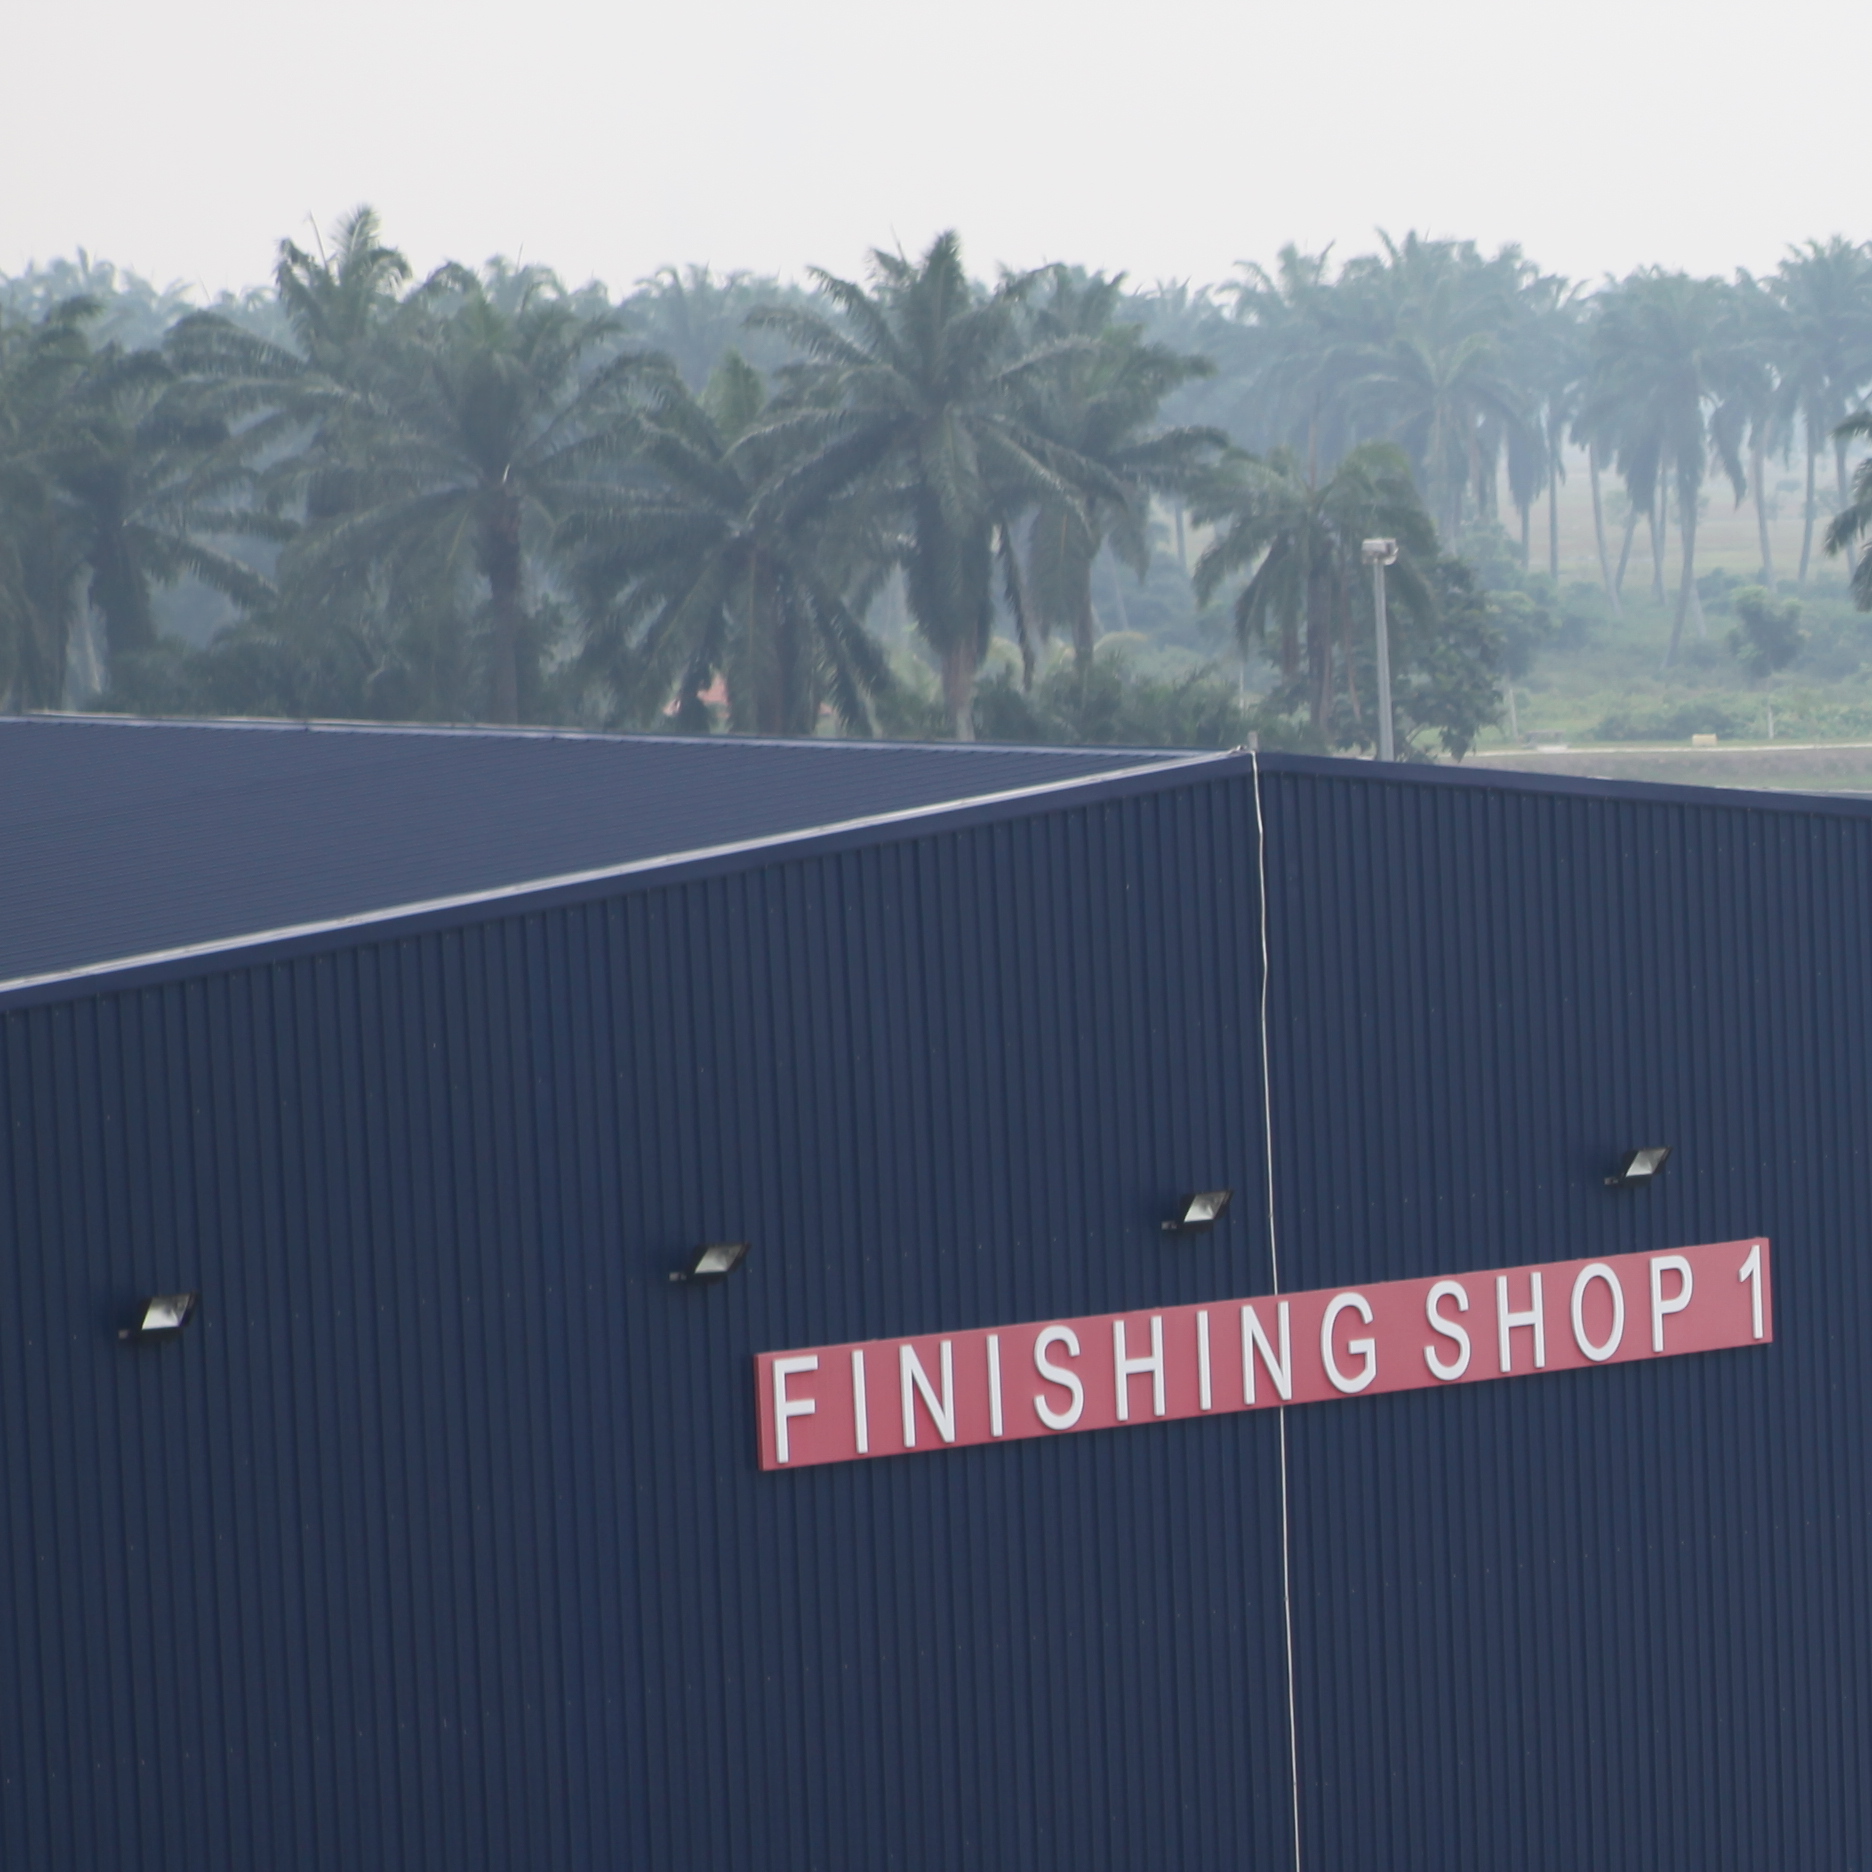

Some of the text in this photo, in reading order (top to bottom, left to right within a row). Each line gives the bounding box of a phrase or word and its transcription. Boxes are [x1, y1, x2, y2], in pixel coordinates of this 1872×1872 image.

[772, 1244, 1764, 1463] FINISHING SHOP 1
